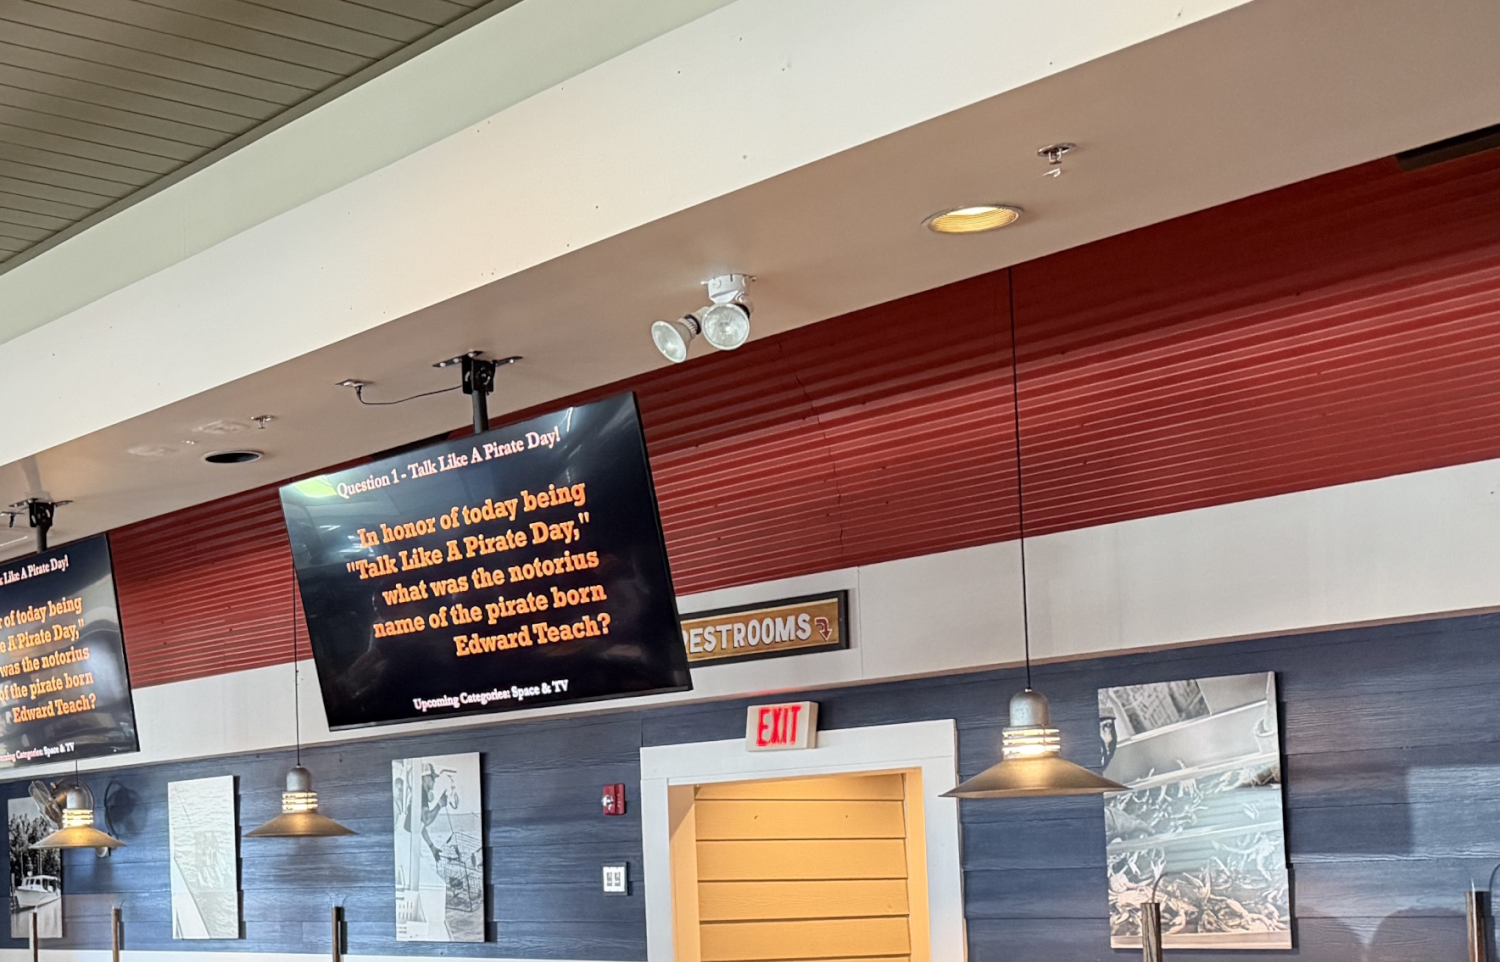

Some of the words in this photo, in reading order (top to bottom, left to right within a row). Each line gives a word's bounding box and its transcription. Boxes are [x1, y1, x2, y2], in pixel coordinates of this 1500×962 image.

[337, 475, 391, 499] Question
[391, 469, 401, 484] 1
[407, 461, 438, 479] Talk
[438, 453, 469, 471] Like
[470, 447, 483, 463] A
[484, 439, 525, 460] Pirate
[525, 426, 561, 450] Day!
[357, 527, 380, 549] In
[381, 515, 437, 543] honor
[440, 509, 460, 530] of
[462, 498, 518, 526] today
[520, 482, 586, 512] being
[346, 556, 398, 580] "Talk
[399, 541, 443, 571] Like
[446, 541, 463, 562] A
[465, 530, 528, 559] Pirate
[530, 512, 590, 545] Day,"
[3, 569, 20, 585] Like
[20, 567, 28, 580] A
[28, 562, 50, 578] Pirate
[50, 554, 70, 573] Day!
[382, 583, 428, 606] what
[430, 576, 469, 597] was
[471, 567, 505, 591] the
[509, 550, 600, 583] notorius
[4, 609, 16, 627] of
[16, 605, 47, 625] today
[48, 596, 83, 618] being
[373, 613, 425, 638] name
[428, 606, 449, 629] of
[450, 604, 483, 626] the
[486, 593, 548, 624] pirate
[550, 584, 607, 608] born
[8, 638, 17, 653] A
[17, 631, 51, 650] Pirate
[52, 619, 85, 642] Day,"
[453, 626, 533, 657] Edward
[532, 612, 611, 645] Teach?
[0, 662, 21, 678] was
[21, 656, 40, 673] the
[41, 646, 90, 668] notorius
[10, 682, 28, 700] the
[29, 677, 63, 699] pirate
[64, 672, 94, 688] born
[412, 695, 460, 711] Upcoming
[459, 689, 511, 708] Categories:
[511, 685, 540, 699] Space
[541, 683, 551, 695] &
[552, 679, 569, 693] TV
[12, 702, 55, 724] Edward
[56, 693, 97, 716] Teach?
[756, 704, 802, 747] EXIT
[43, 746, 59, 756] Space
[65, 742, 75, 752] TV
